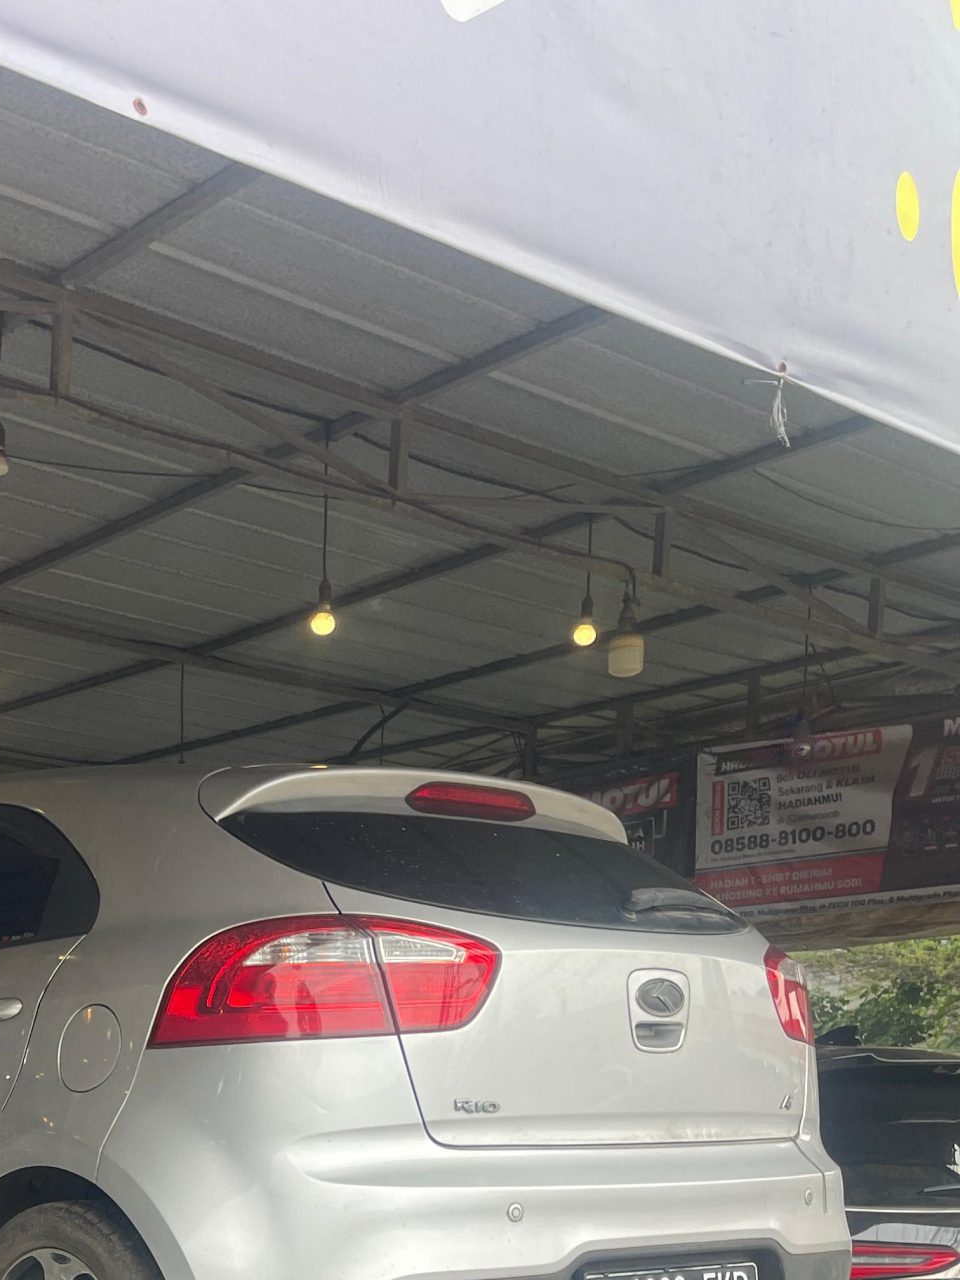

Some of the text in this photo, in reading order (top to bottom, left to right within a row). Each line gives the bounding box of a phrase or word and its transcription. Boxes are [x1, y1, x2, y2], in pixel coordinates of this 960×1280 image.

[797, 731, 877, 757] OTUL
[778, 782, 823, 797] Sekarang
[836, 774, 875, 788] KLAIM
[710, 819, 876, 855] 08588-8100-800
[710, 877, 748, 890] HADIAH
[714, 889, 764, 902] ANGSUNG
[780, 882, 835, 895] RUMAHMU
